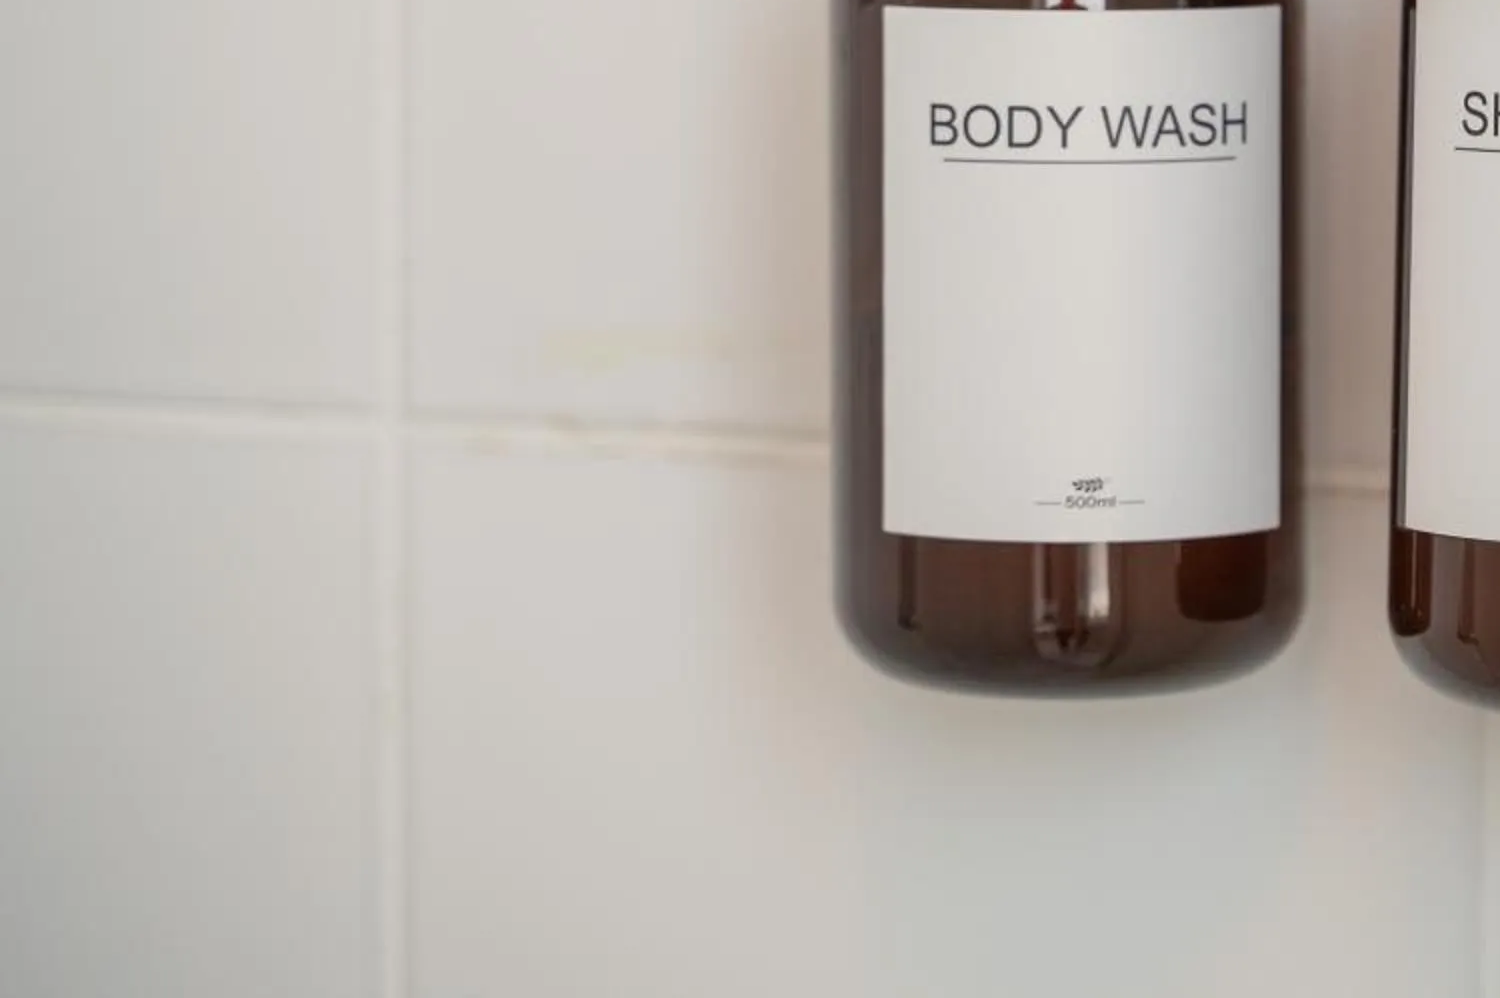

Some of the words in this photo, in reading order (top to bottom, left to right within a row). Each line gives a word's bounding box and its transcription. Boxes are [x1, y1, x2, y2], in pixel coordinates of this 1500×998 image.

[929, 103, 1084, 149] BODY
[1100, 101, 1249, 149] WASH
[1064, 494, 1117, 510] 500ml
